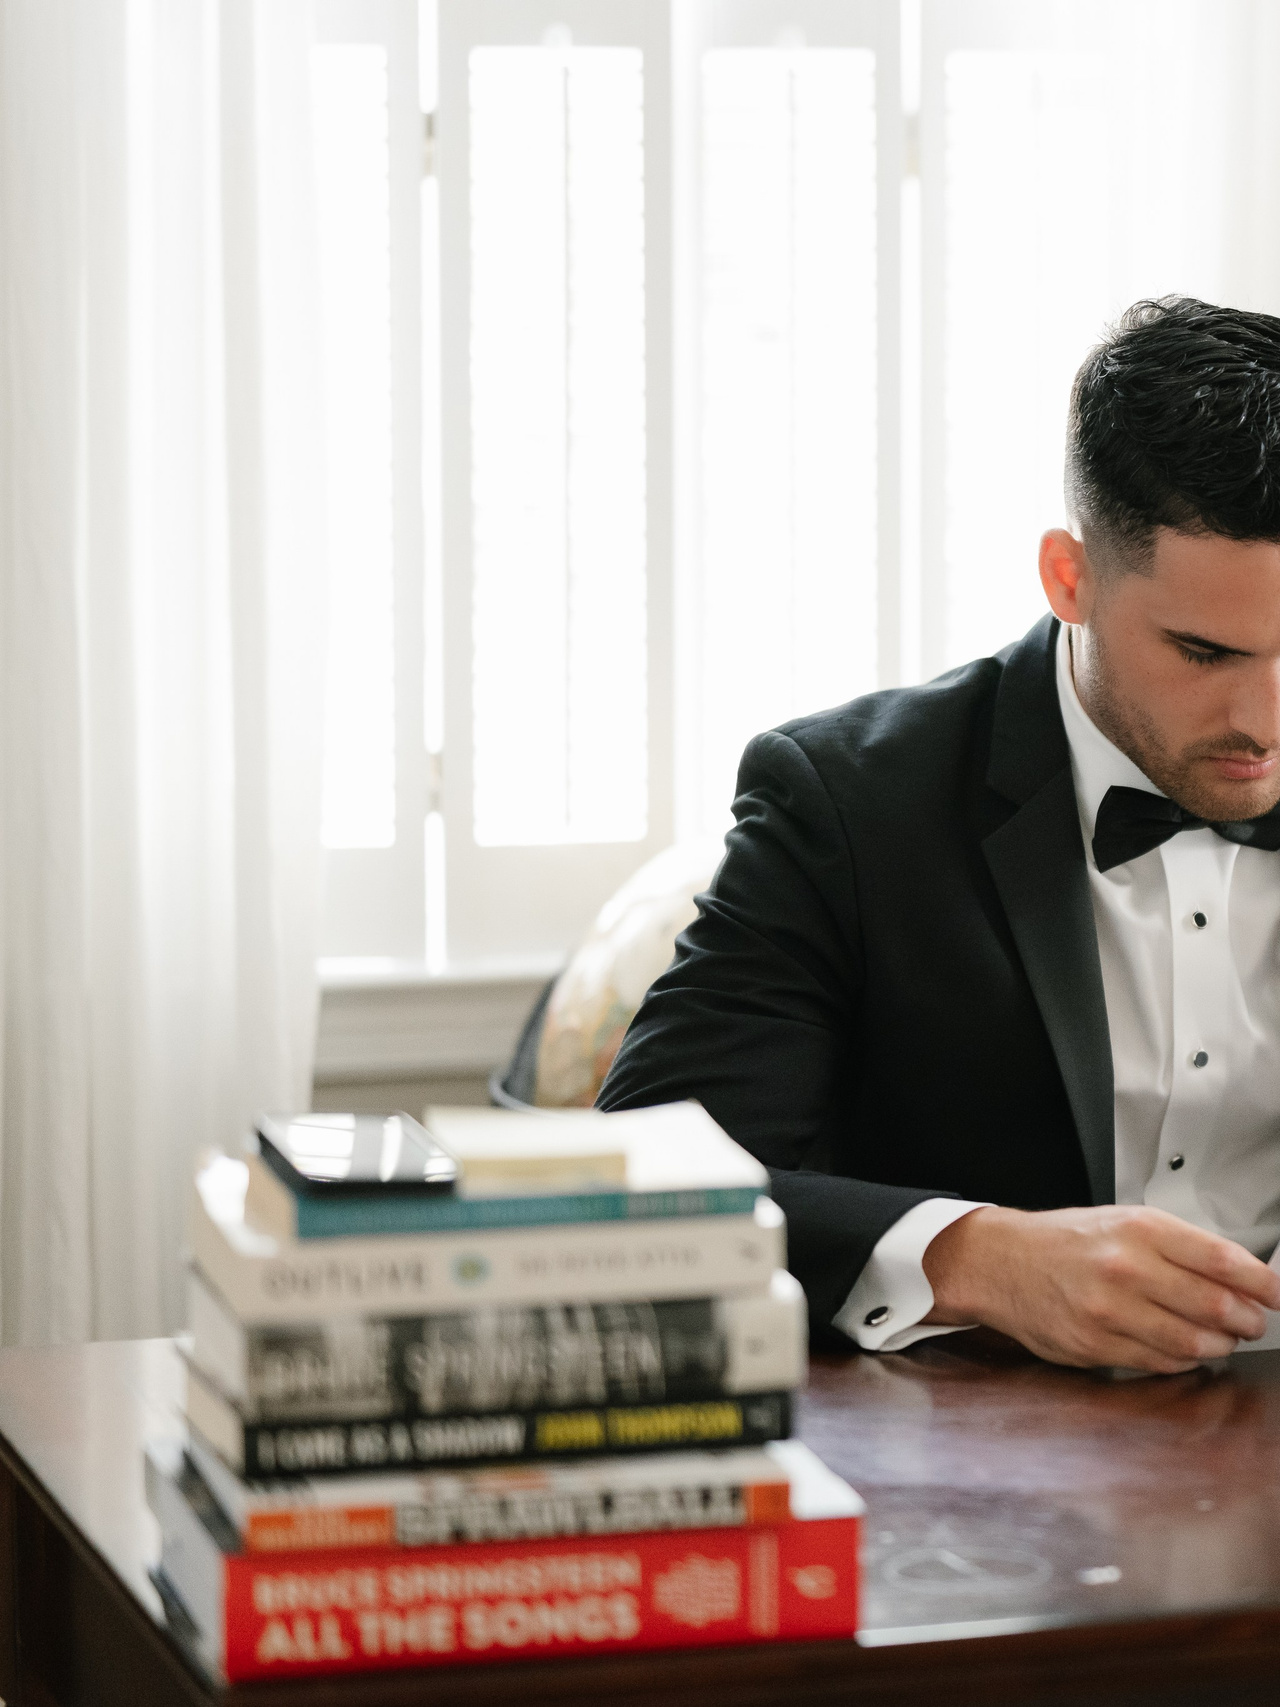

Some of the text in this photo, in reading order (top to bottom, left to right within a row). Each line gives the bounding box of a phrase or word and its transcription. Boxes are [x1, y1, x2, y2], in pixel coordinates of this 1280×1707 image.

[538, 1411, 601, 1448] JOHN
[608, 1402, 743, 1442] THOMPSON
[253, 1569, 378, 1615] BRUCE
[386, 1552, 642, 1600] SPRINGSTEEN
[255, 1593, 642, 1664] ALL THE SONGS
